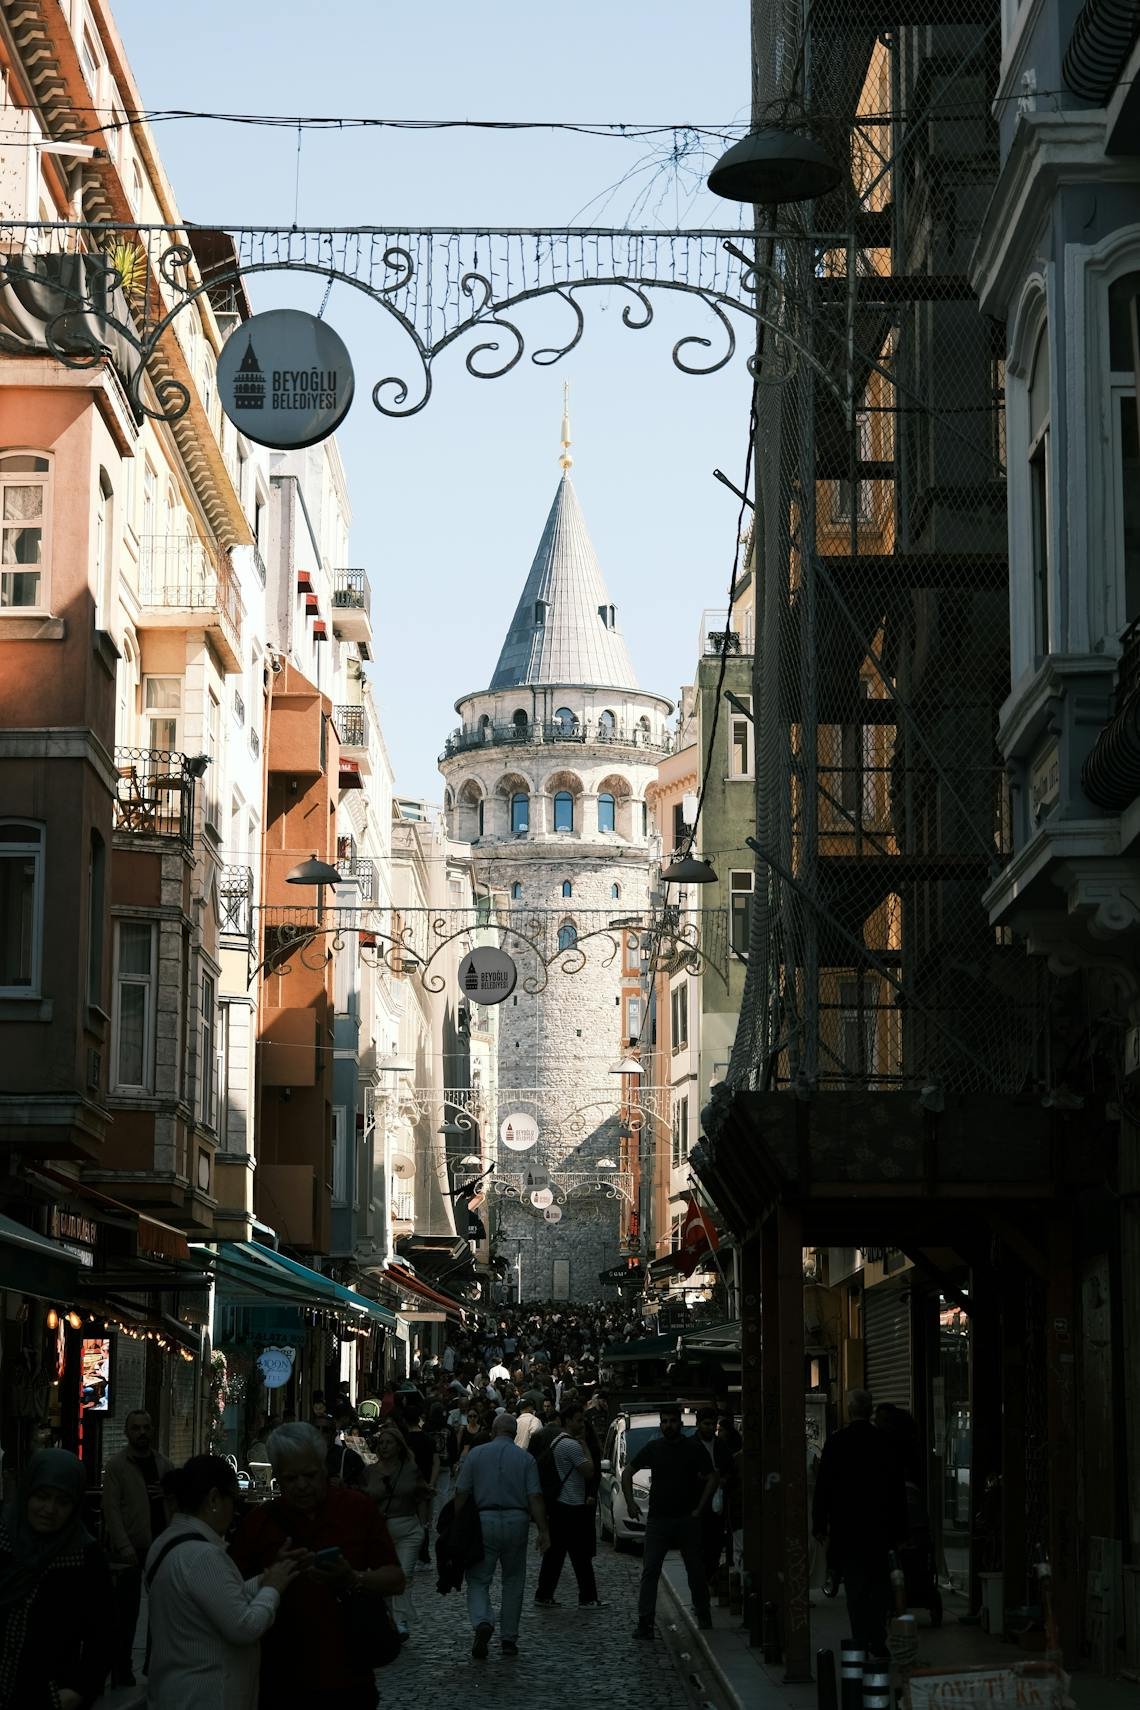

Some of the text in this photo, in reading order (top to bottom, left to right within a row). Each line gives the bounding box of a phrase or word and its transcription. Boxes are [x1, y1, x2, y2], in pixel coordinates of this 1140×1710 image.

[272, 367, 337, 392] BEYOĞLU
[272, 393, 337, 410] BELEDİYESİ
[481, 970, 509, 982] BEYOĞLU
